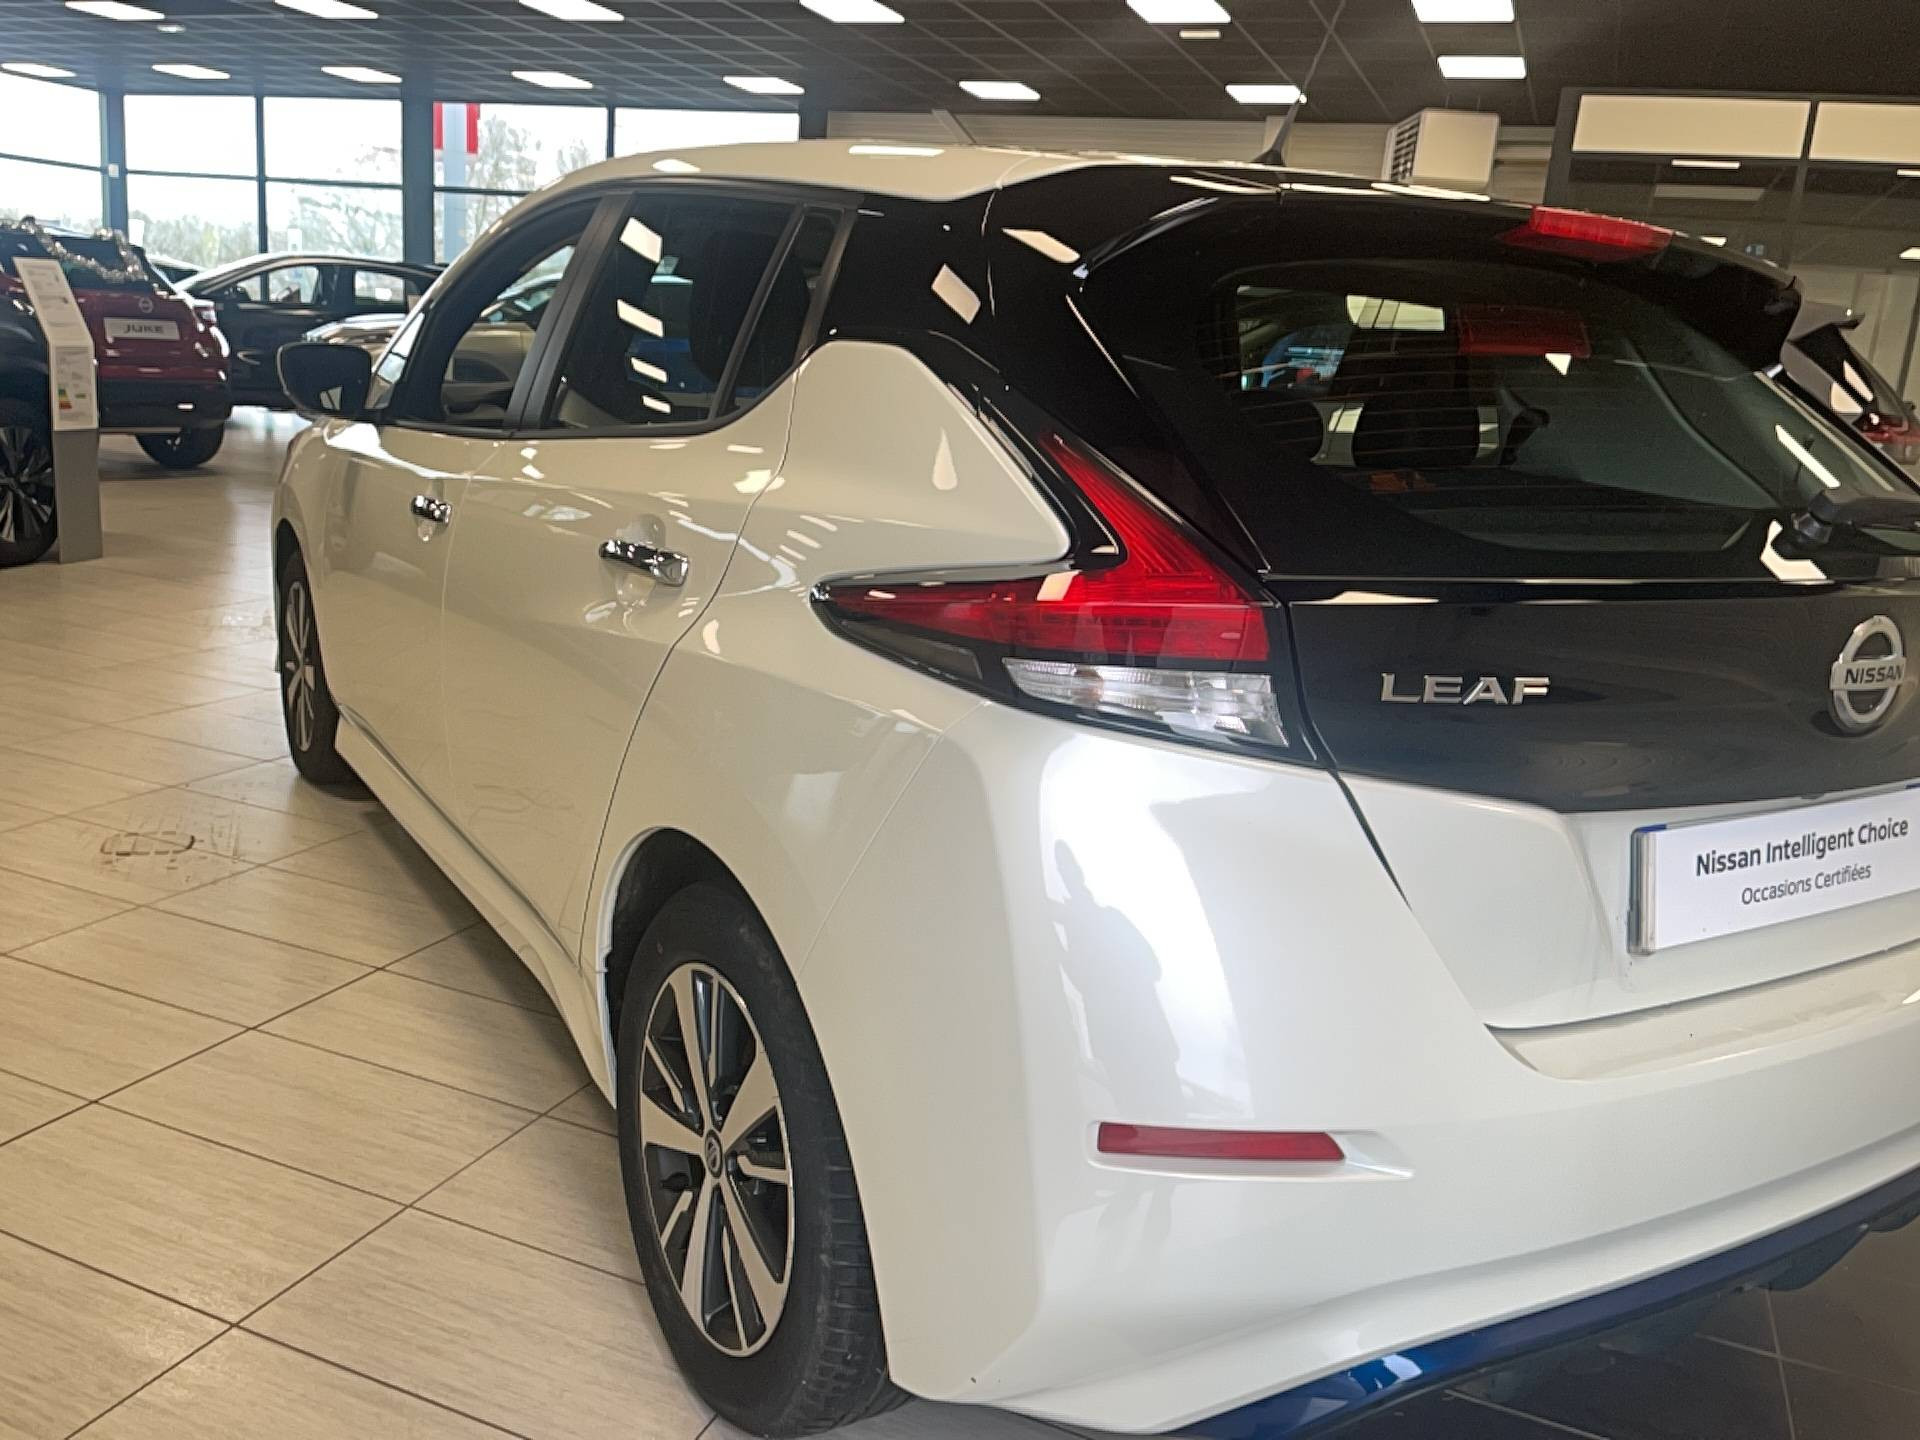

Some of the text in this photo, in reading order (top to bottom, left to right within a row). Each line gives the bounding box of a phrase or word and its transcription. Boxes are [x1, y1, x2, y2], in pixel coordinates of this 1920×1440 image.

[124, 324, 164, 334] JUKE
[1381, 672, 1550, 705] LEAF
[1844, 665, 1904, 685] NISSAN
[1696, 817, 1909, 877] Nissan Intelligent Choice
[1742, 862, 1872, 905] Occasions Certifiées
